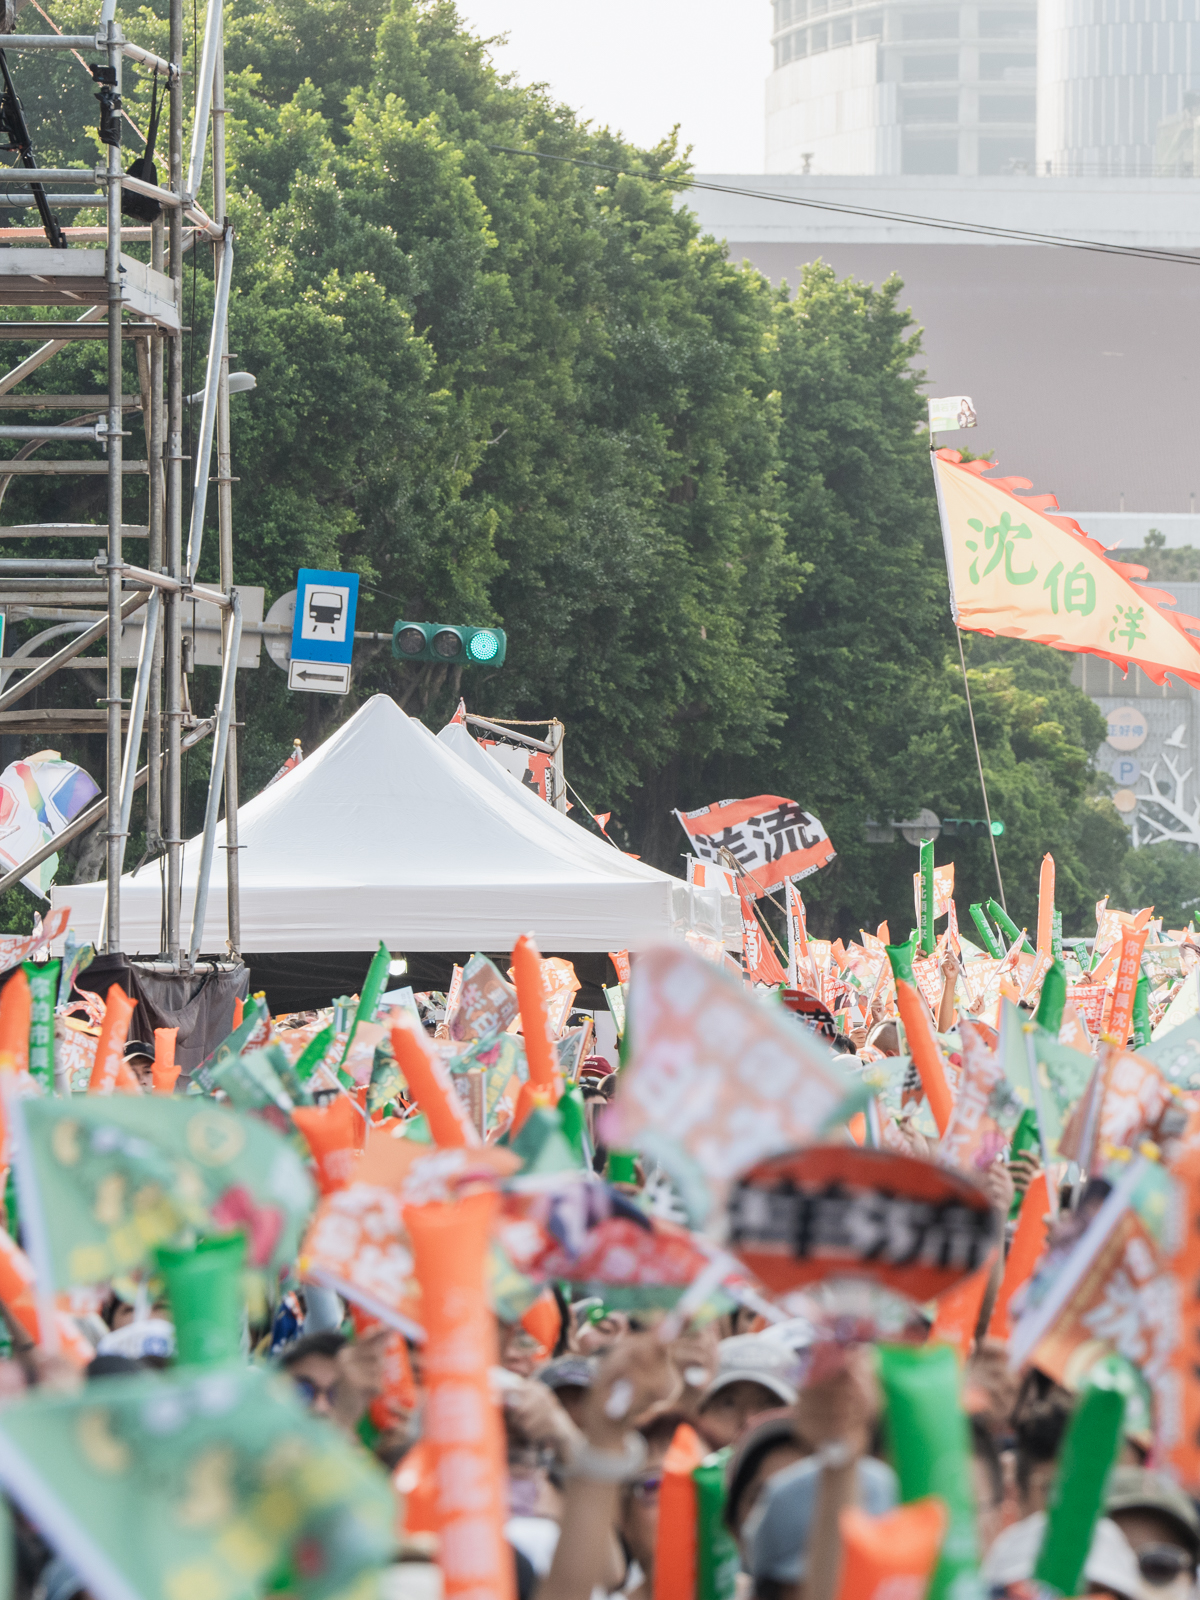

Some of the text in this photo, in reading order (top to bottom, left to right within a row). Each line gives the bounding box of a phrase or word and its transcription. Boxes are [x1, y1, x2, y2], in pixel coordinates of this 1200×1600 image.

[965, 511, 1146, 651] 沈伯洋
[1119, 761, 1133, 780] P
[694, 802, 821, 878] 洋流
